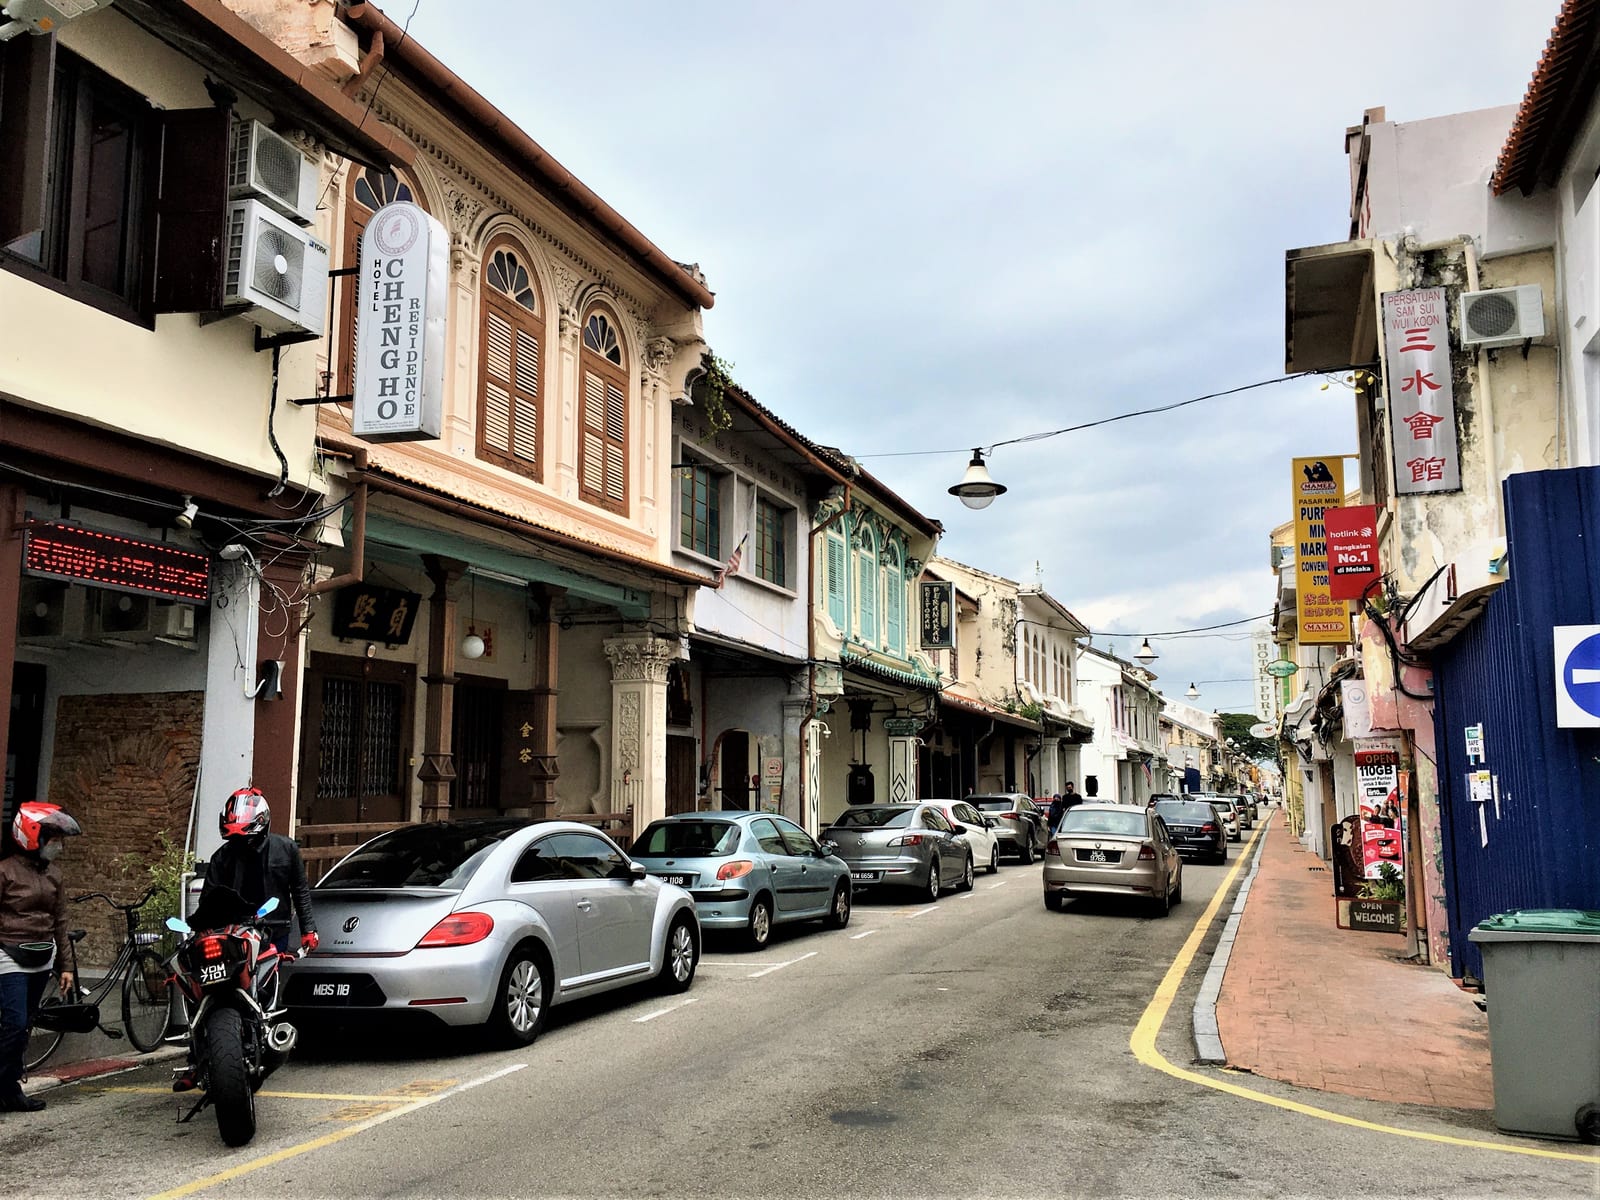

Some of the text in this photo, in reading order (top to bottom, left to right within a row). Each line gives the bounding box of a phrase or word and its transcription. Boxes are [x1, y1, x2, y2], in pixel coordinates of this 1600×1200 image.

[314, 243, 328, 256] YORK
[373, 259, 382, 312] HOTEL
[1388, 290, 1441, 305] PERSATUAN
[380, 258, 405, 370] CHENG
[1396, 303, 1435, 317] SAM SUI
[1392, 314, 1440, 329] WUI KOON
[403, 297, 421, 416] RESIDENCE
[377, 377, 400, 420] HO
[1400, 327, 1446, 483] 三水會館
[1309, 524, 1327, 539] MIN
[1329, 529, 1359, 538] hotlink
[1300, 542, 1328, 556] MARK
[1333, 543, 1372, 551] Rangkaian
[1337, 550, 1369, 563] No.1
[1345, 565, 1371, 573] Melaka
[1312, 575, 1330, 586] STOR
[1257, 643, 1269, 683] HOTEL
[1260, 685, 1270, 717] PURI
[1365, 754, 1394, 764] OPEN
[1359, 764, 1393, 777] 110GB
[1361, 902, 1382, 910] OPEN
[1354, 911, 1395, 925] WELCOME
[313, 984, 351, 996] MBS 118
